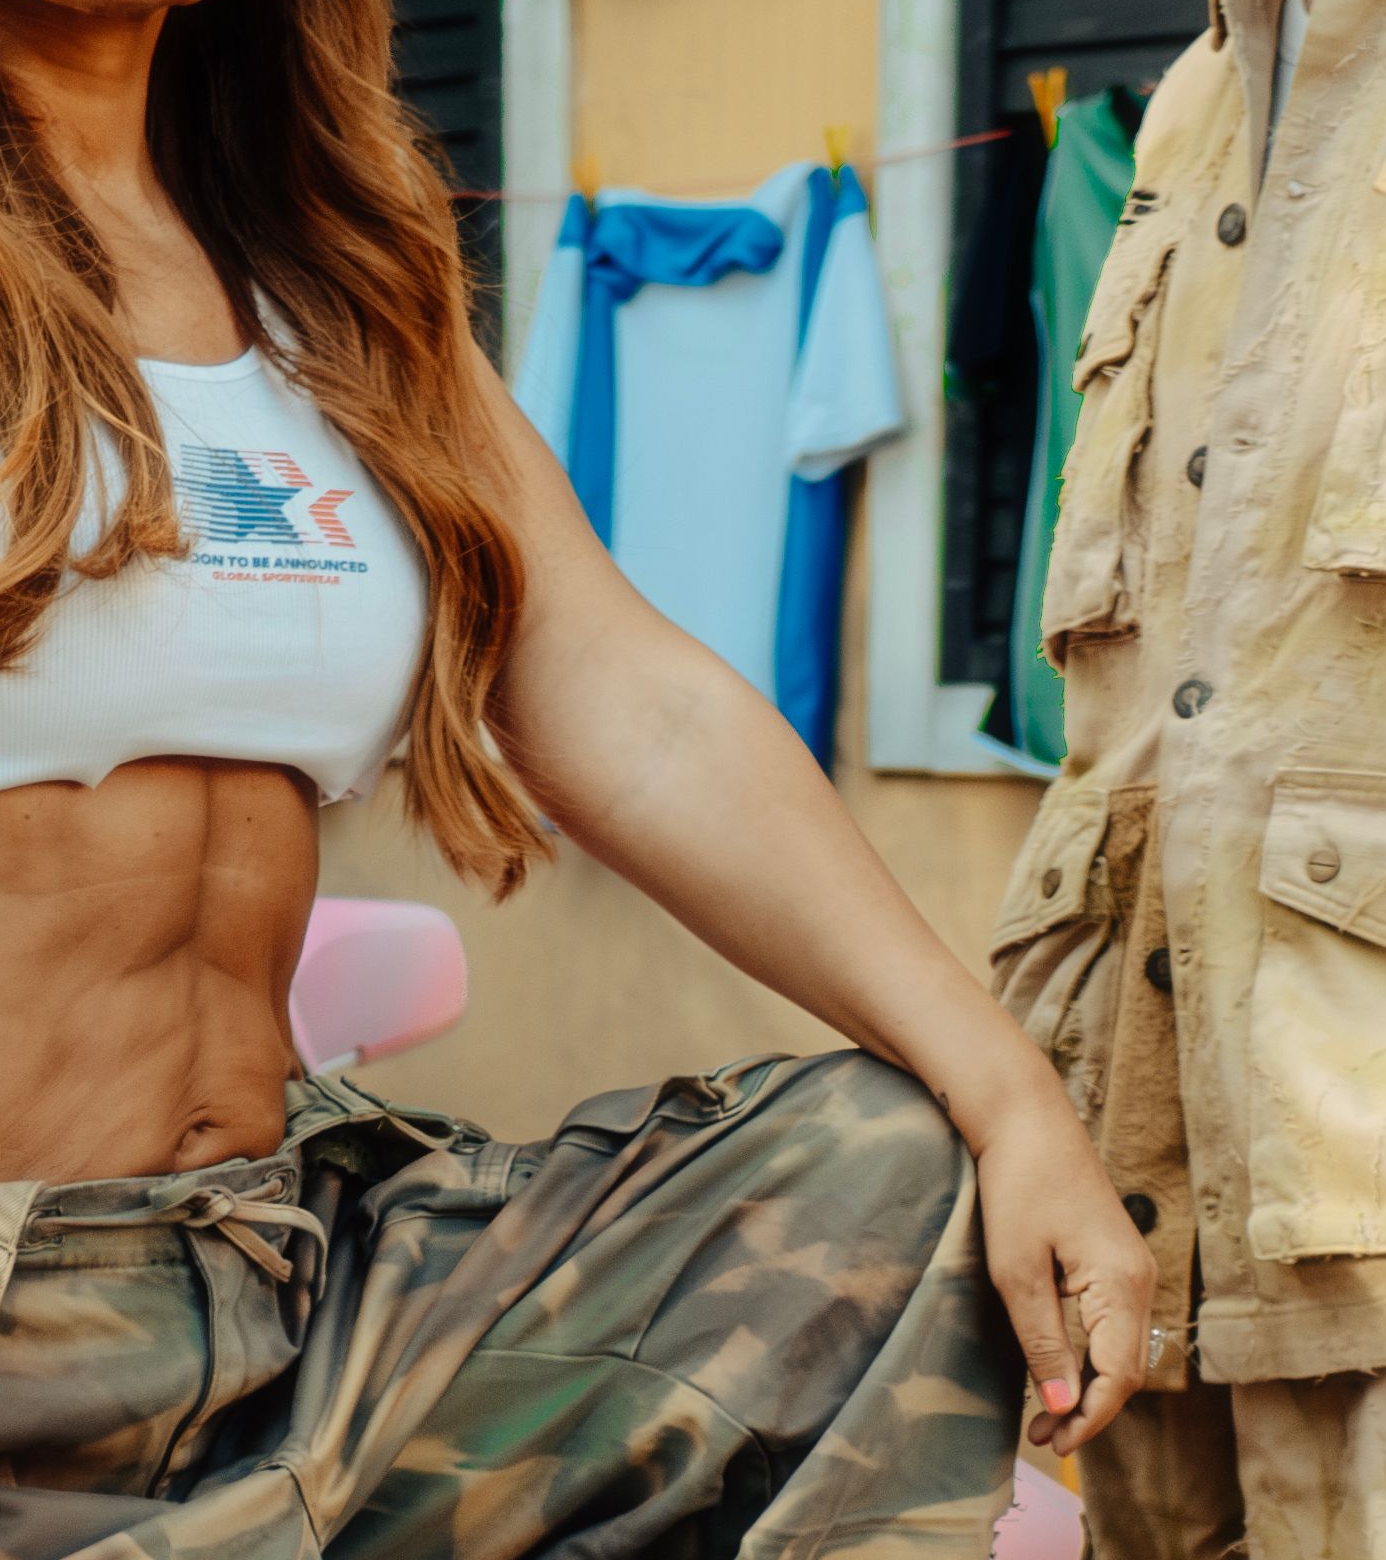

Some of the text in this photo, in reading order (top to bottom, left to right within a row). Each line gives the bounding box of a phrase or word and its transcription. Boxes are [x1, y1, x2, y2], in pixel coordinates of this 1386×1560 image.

[227, 556, 249, 568] TO
[252, 557, 270, 569] BE
[273, 559, 368, 573] ANNOUNCED
[213, 571, 258, 582] GLOBAL
